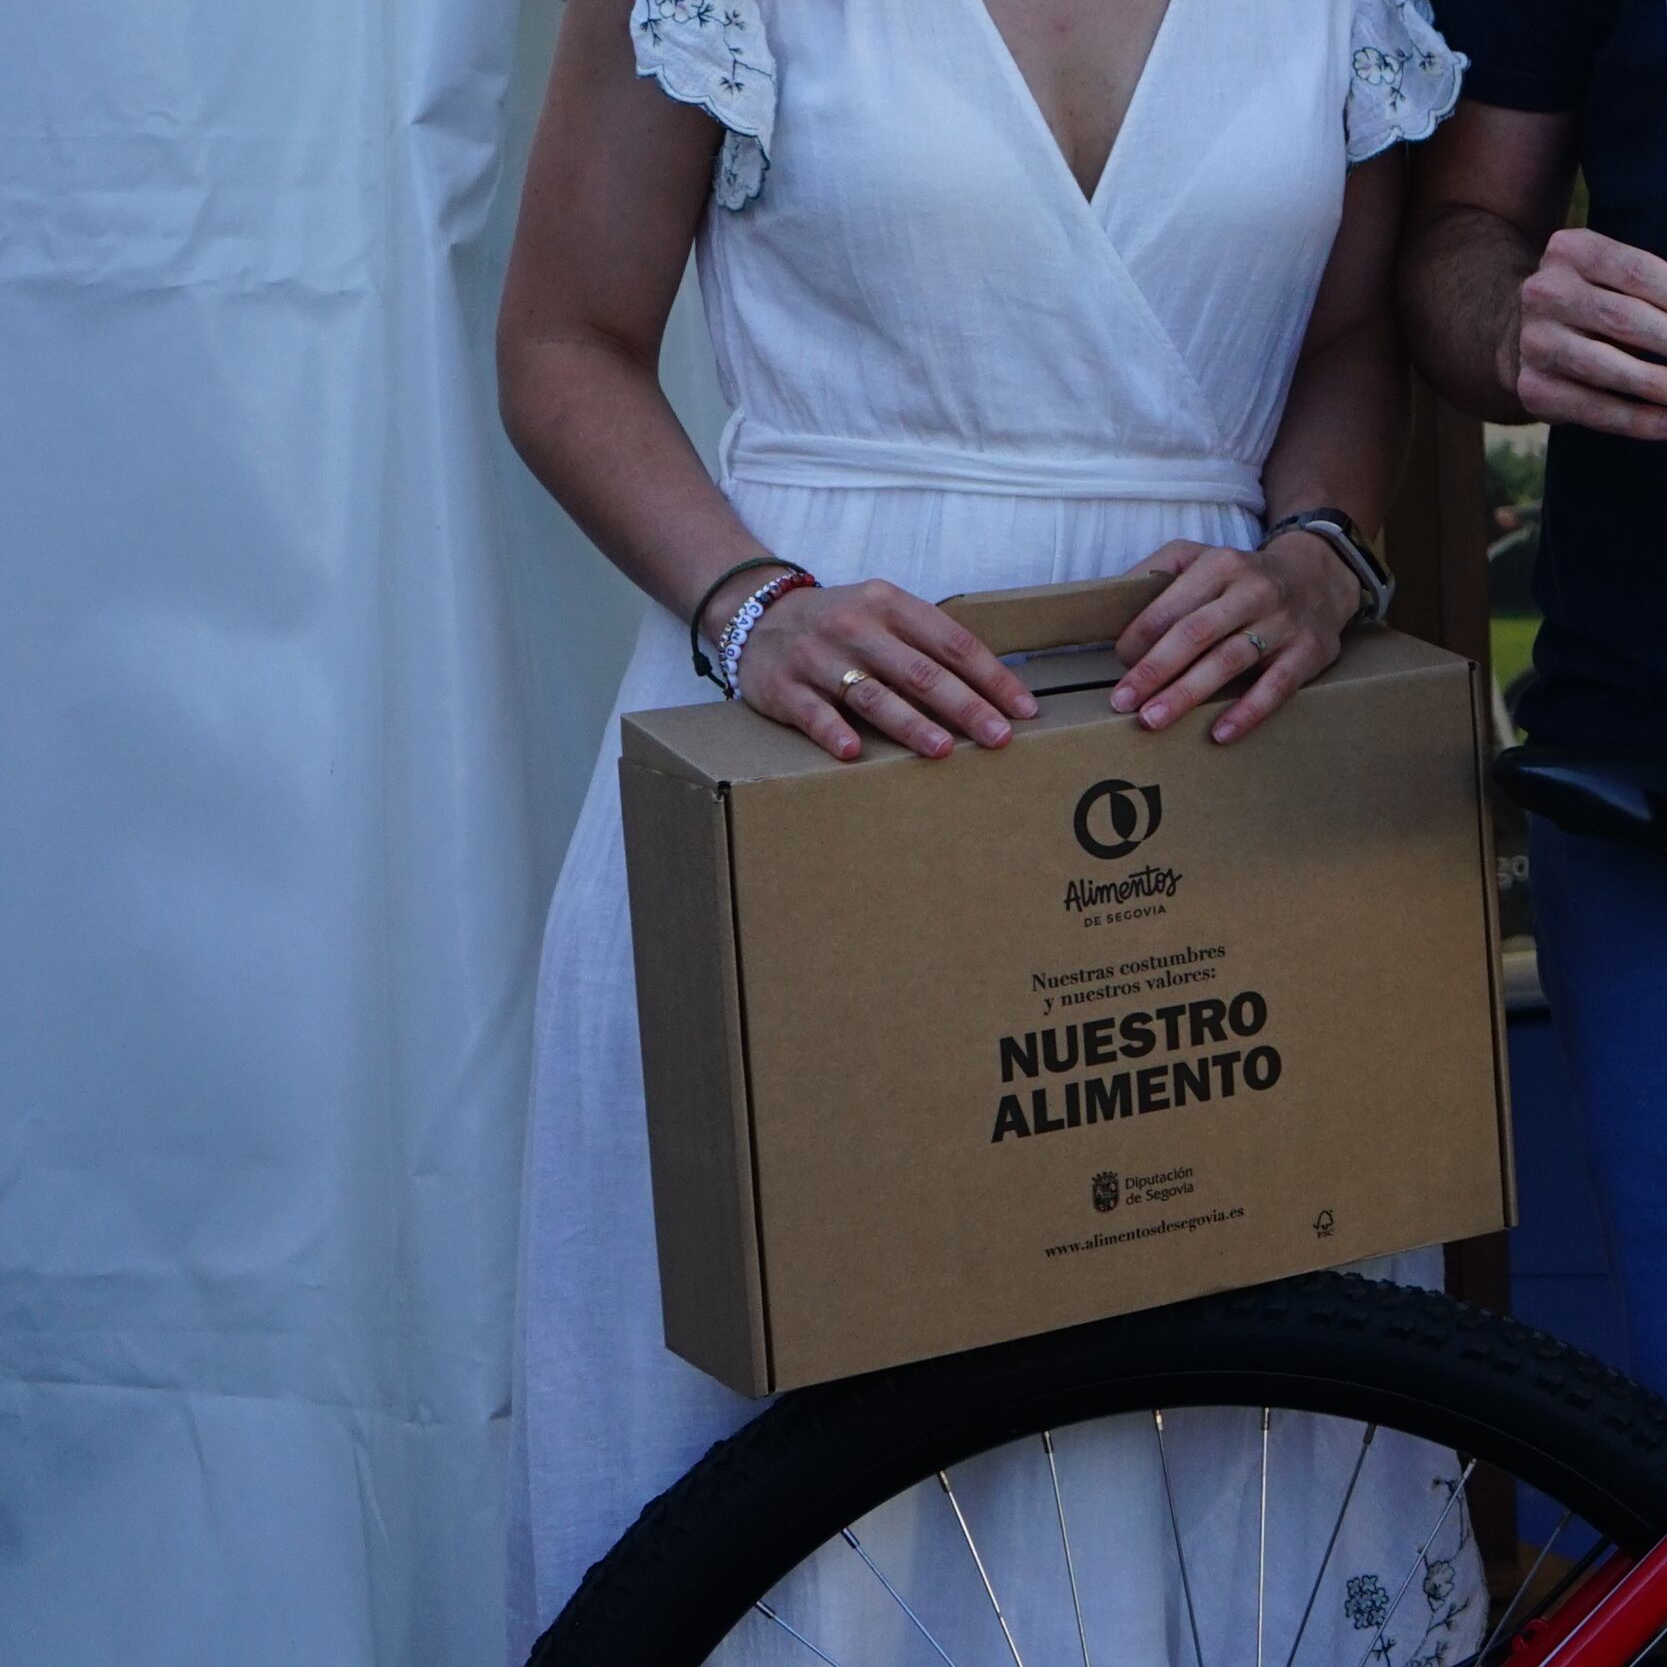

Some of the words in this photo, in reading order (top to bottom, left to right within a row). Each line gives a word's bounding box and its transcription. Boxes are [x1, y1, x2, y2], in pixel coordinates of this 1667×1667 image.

[1064, 865, 1183, 913] Alimentos
[1084, 916, 1101, 928] DE
[1106, 905, 1167, 924] SEGOVIA
[1031, 964, 1115, 992] Nuestras
[1119, 944, 1227, 976] costumbres
[1043, 995, 1056, 1015] y
[1060, 982, 1141, 1009] nuestros
[1146, 966, 1217, 991] valores:
[999, 990, 1268, 1083] NUESTRO
[991, 1045, 1282, 1143] ALIMENTO
[1125, 1166, 1194, 1190] Diputación
[1126, 1192, 1142, 1206] de
[1146, 1182, 1195, 1206] Segovia
[1045, 1206, 1245, 1258] www.alimentosdesegovia.es
